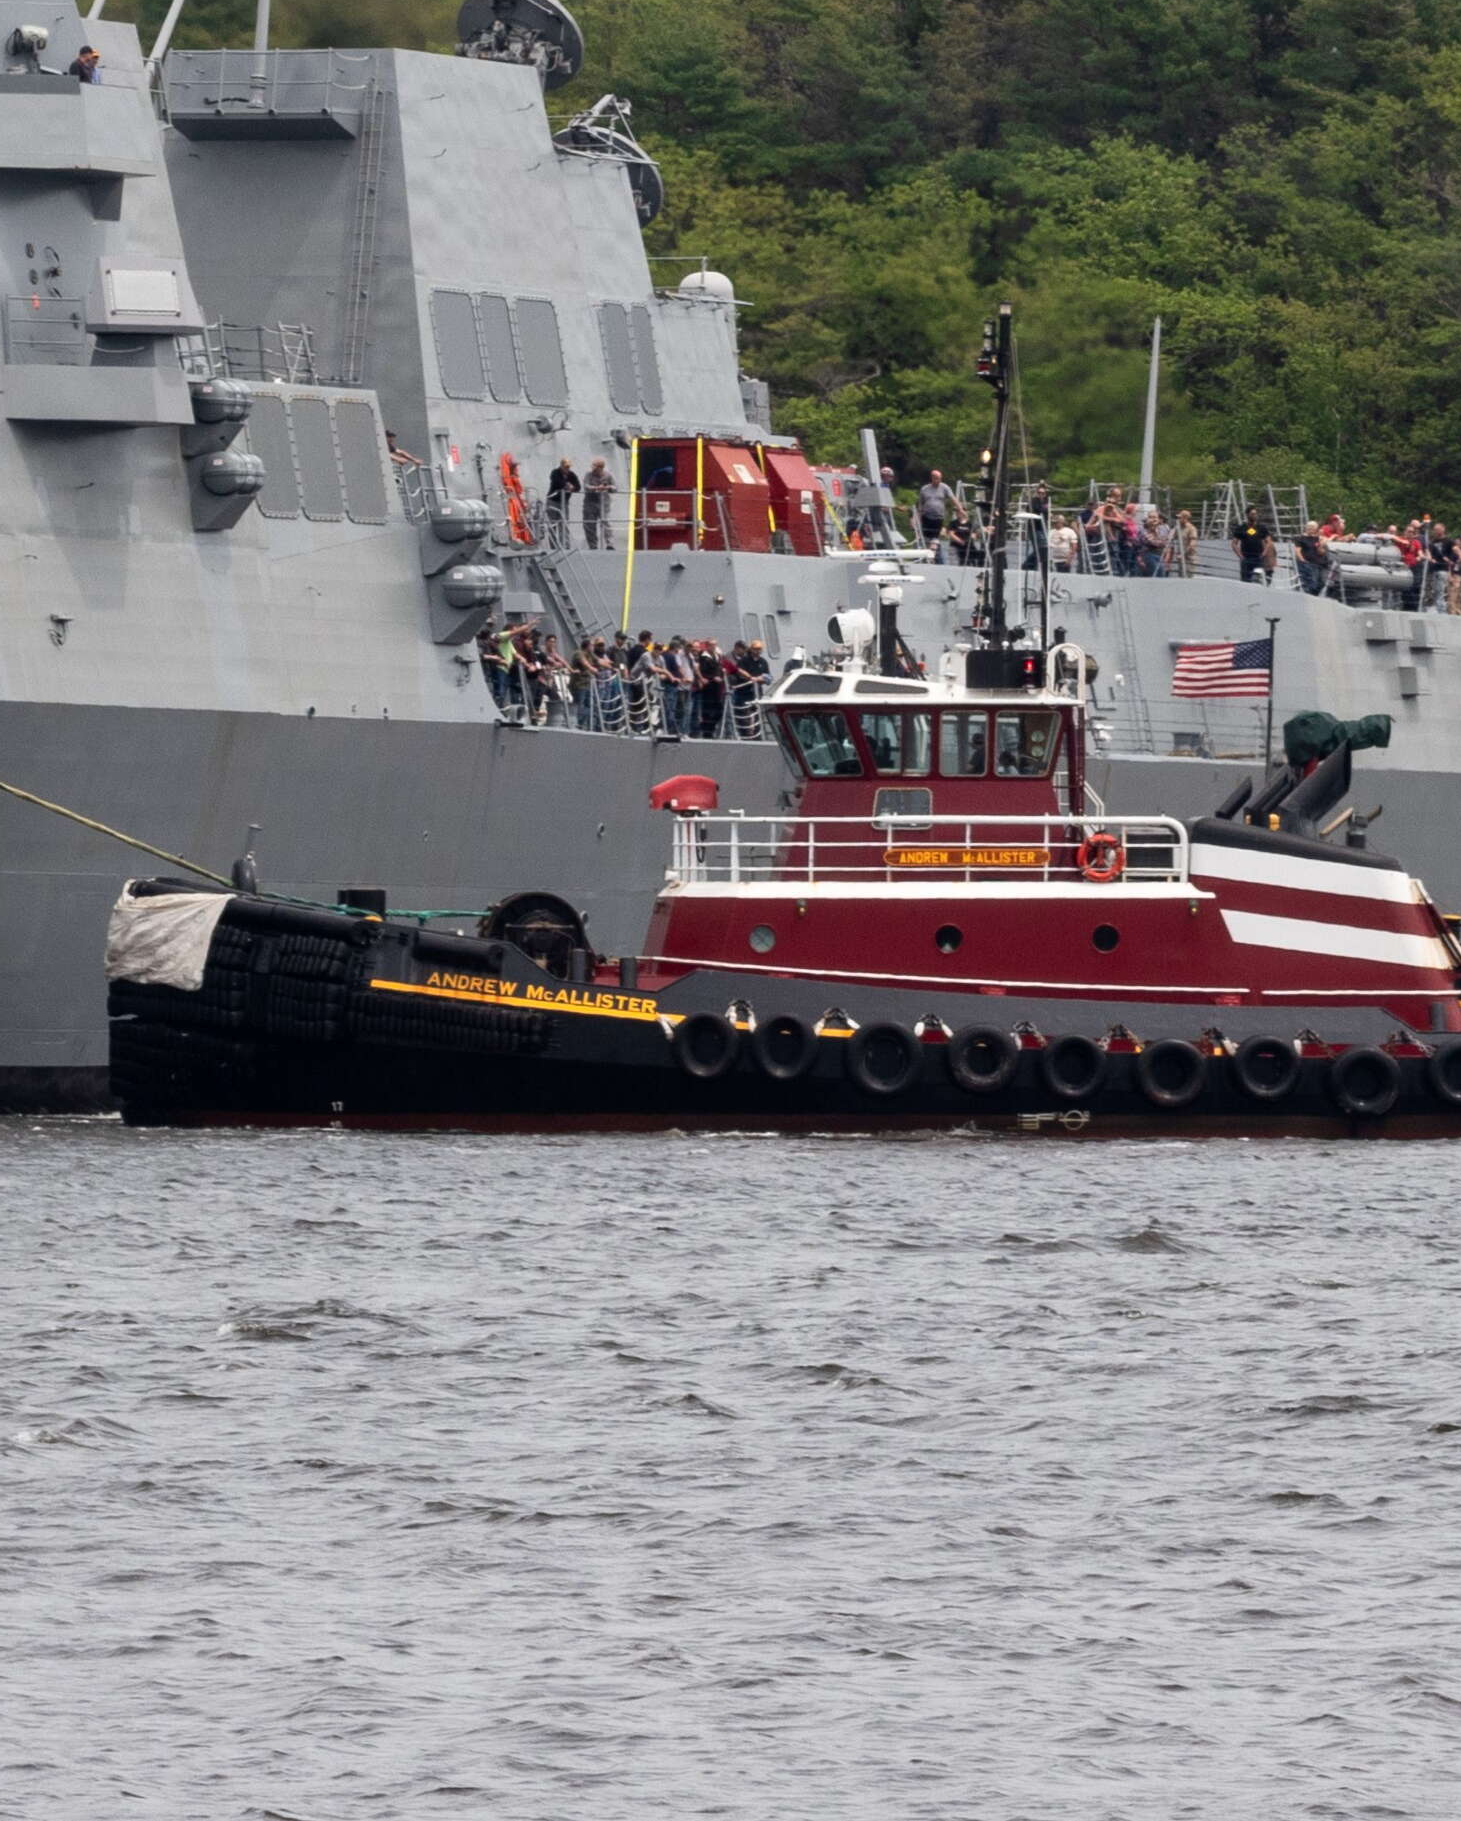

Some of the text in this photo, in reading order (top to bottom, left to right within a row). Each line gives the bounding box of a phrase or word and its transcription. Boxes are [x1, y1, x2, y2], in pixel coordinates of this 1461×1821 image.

[899, 851, 1037, 864] ANDREW McALLISTER
[427, 971, 657, 1014] ANDREW McALLISTER
[331, 1101, 344, 1112] 17
